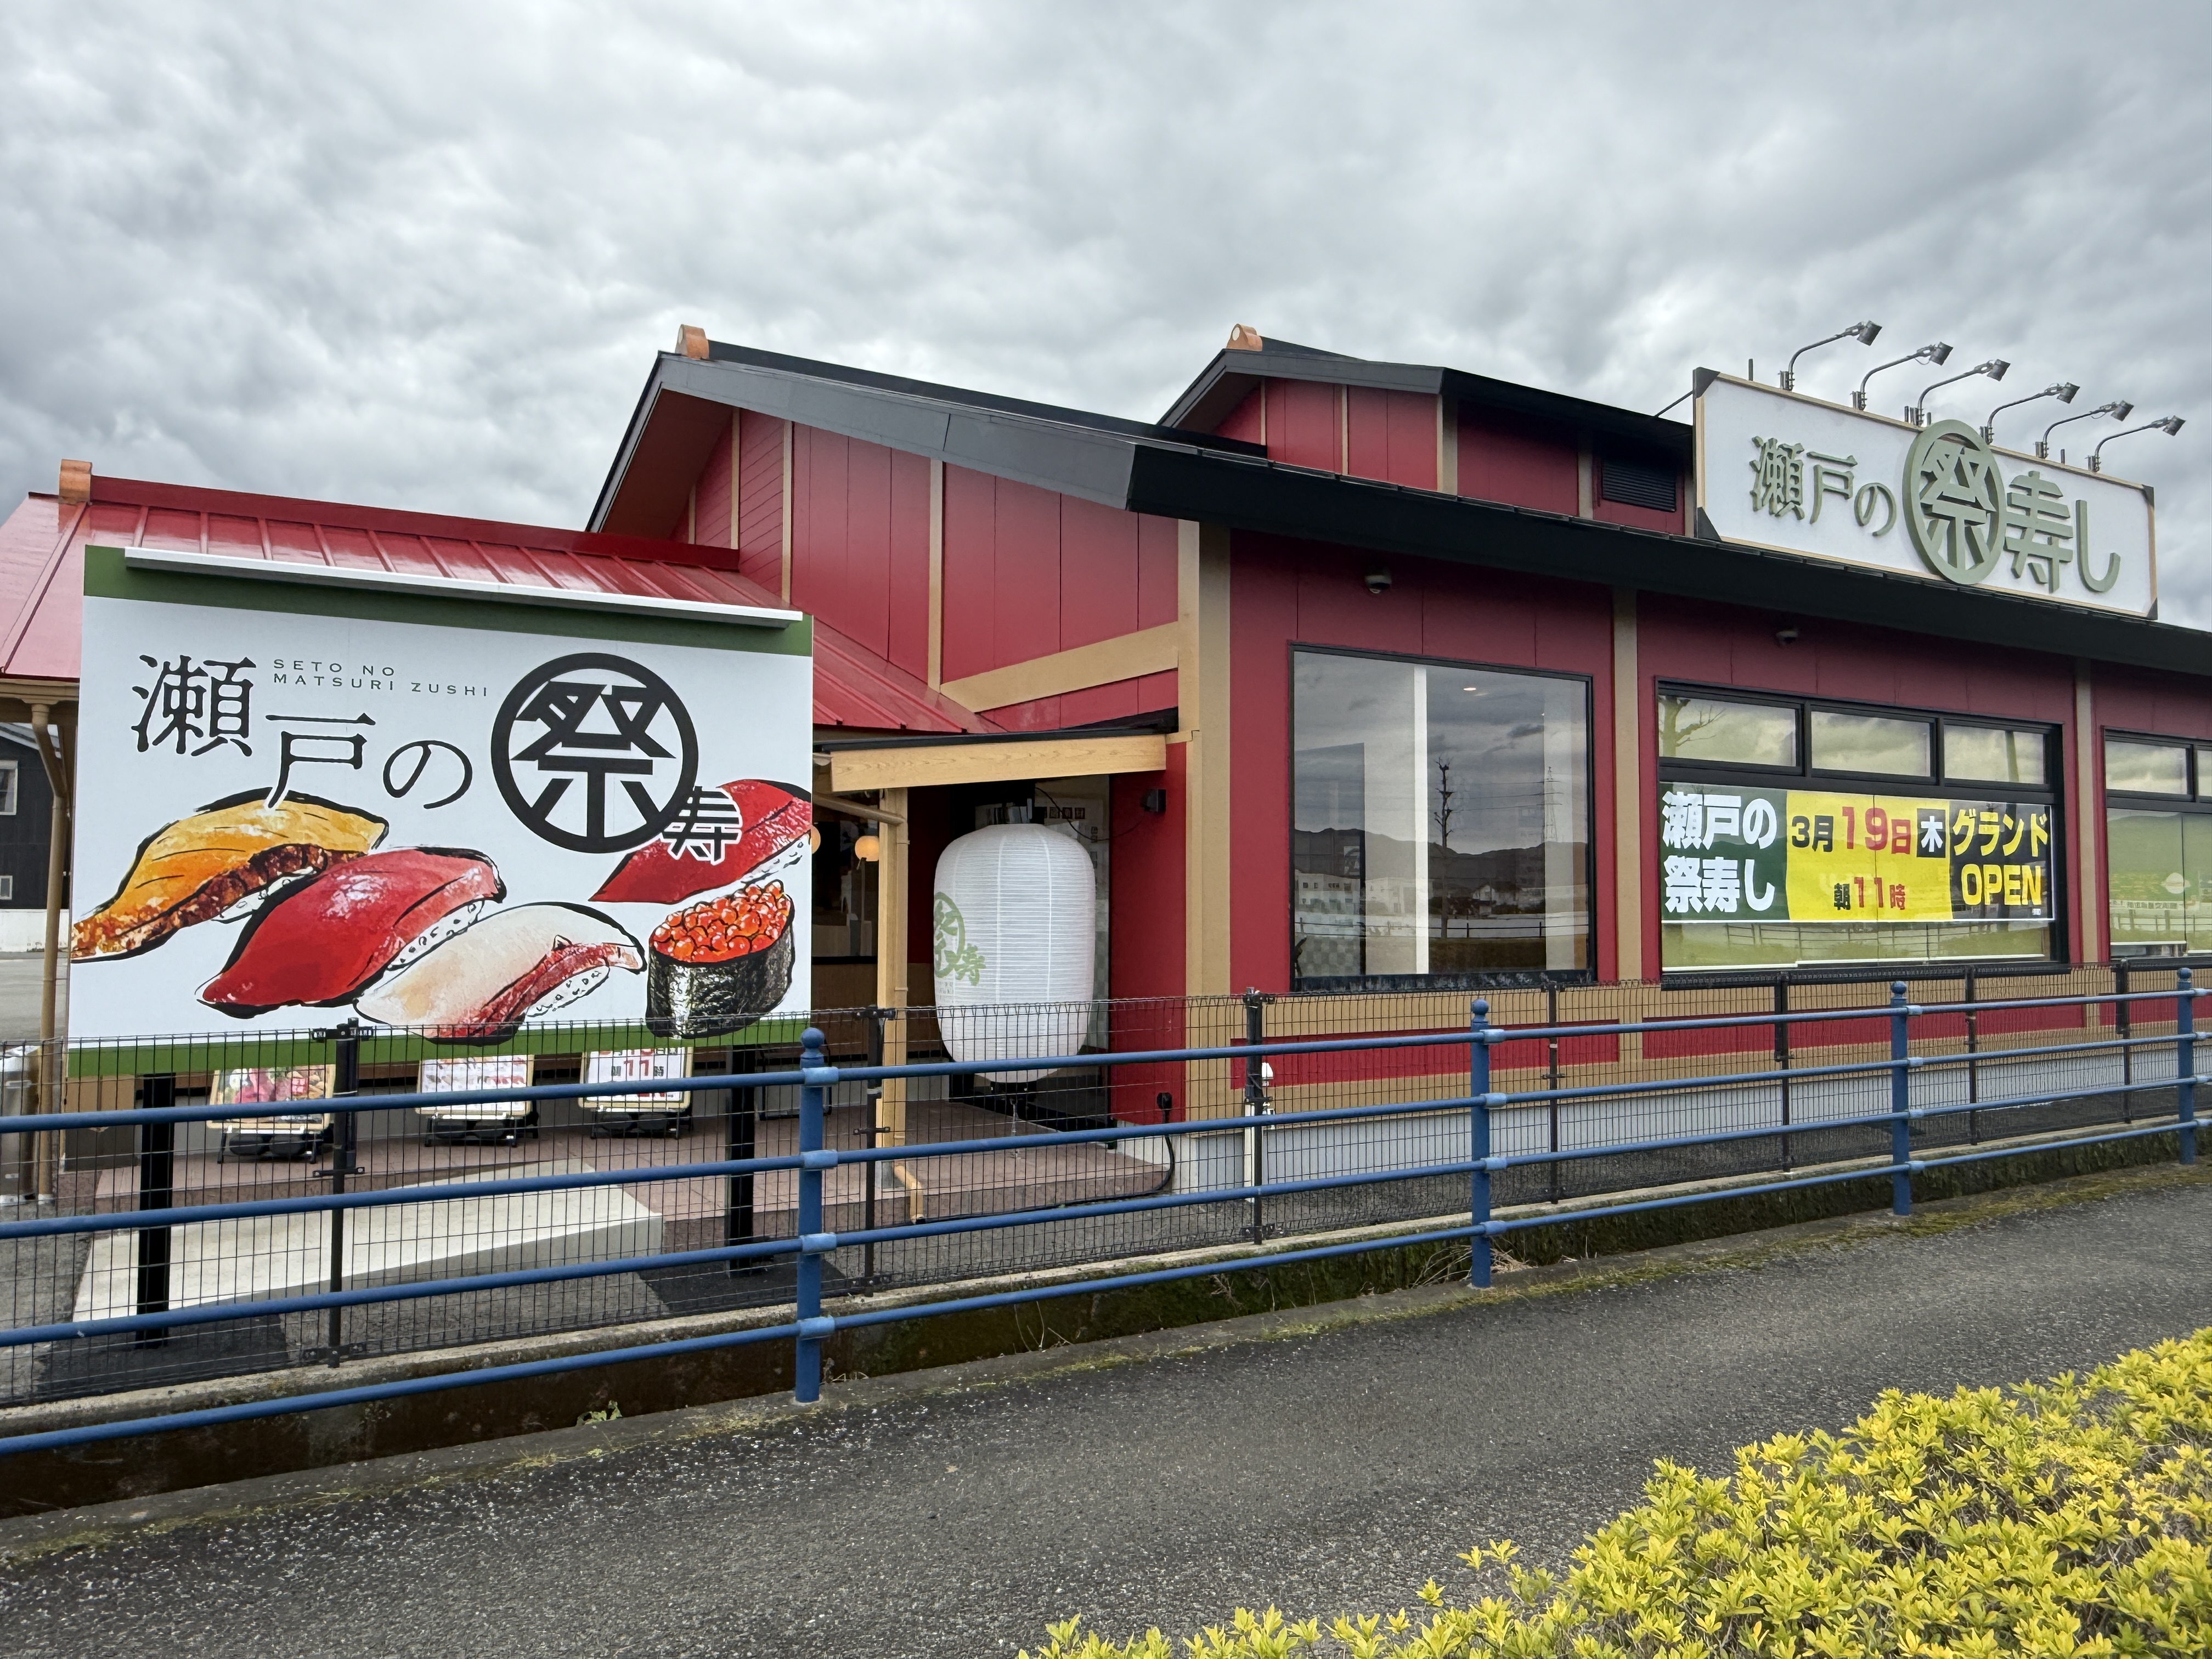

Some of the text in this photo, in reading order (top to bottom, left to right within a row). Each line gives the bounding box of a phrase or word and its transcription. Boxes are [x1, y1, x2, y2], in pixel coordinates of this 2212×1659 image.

[273, 659, 394, 676] SETO NO
[273, 673, 487, 697] MATSURI ZUSHI
[1662, 791, 1777, 850] 瀬戸の
[1953, 808, 2048, 857] グランド
[1663, 855, 1775, 913] 祭寿し
[1961, 864, 2041, 905] OPEN
